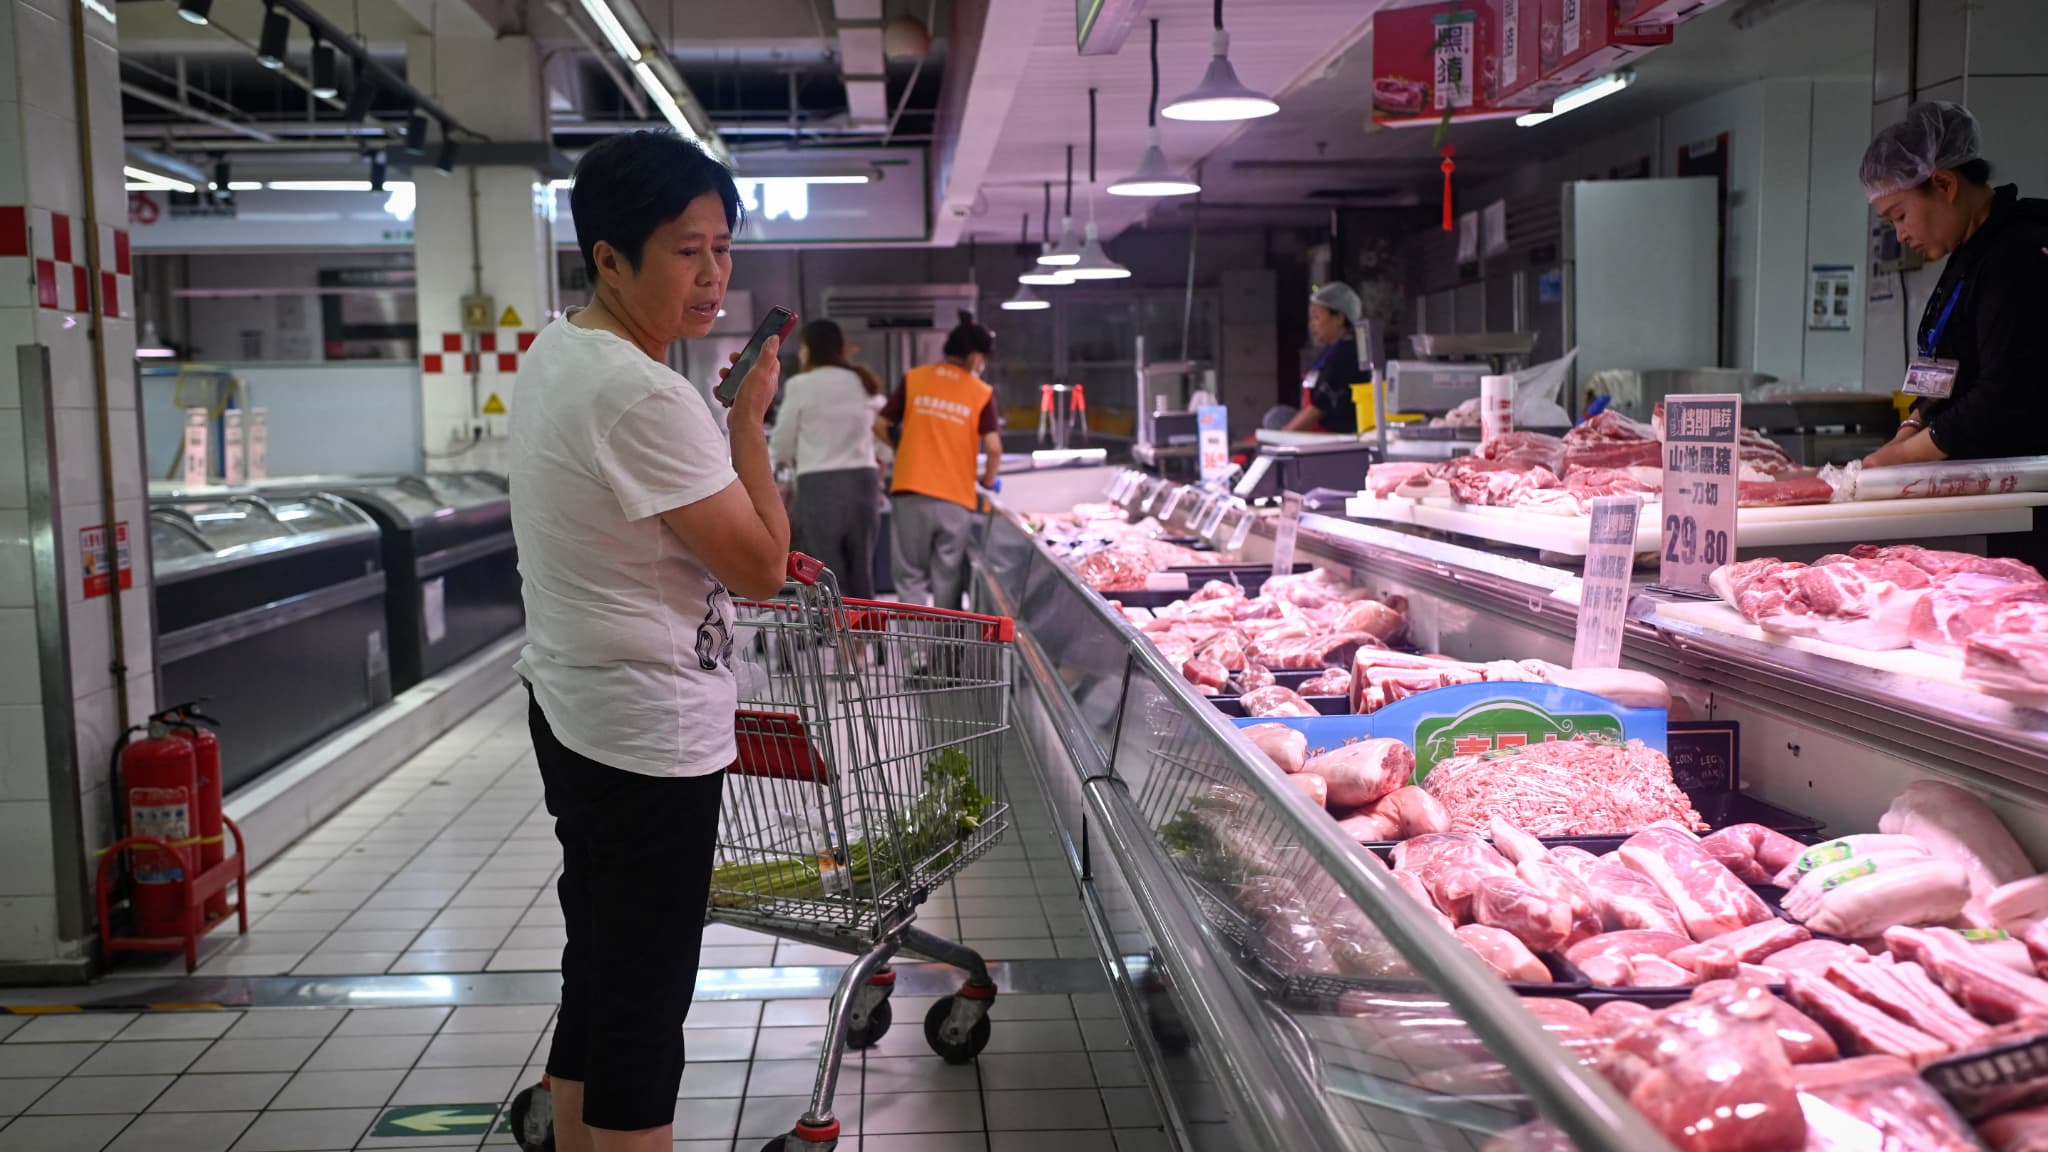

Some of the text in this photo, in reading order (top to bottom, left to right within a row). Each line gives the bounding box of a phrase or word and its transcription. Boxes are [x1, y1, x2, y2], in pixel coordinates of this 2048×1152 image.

[1679, 482, 1718, 506] 一刀切
[1665, 514, 1728, 566] 29.80
